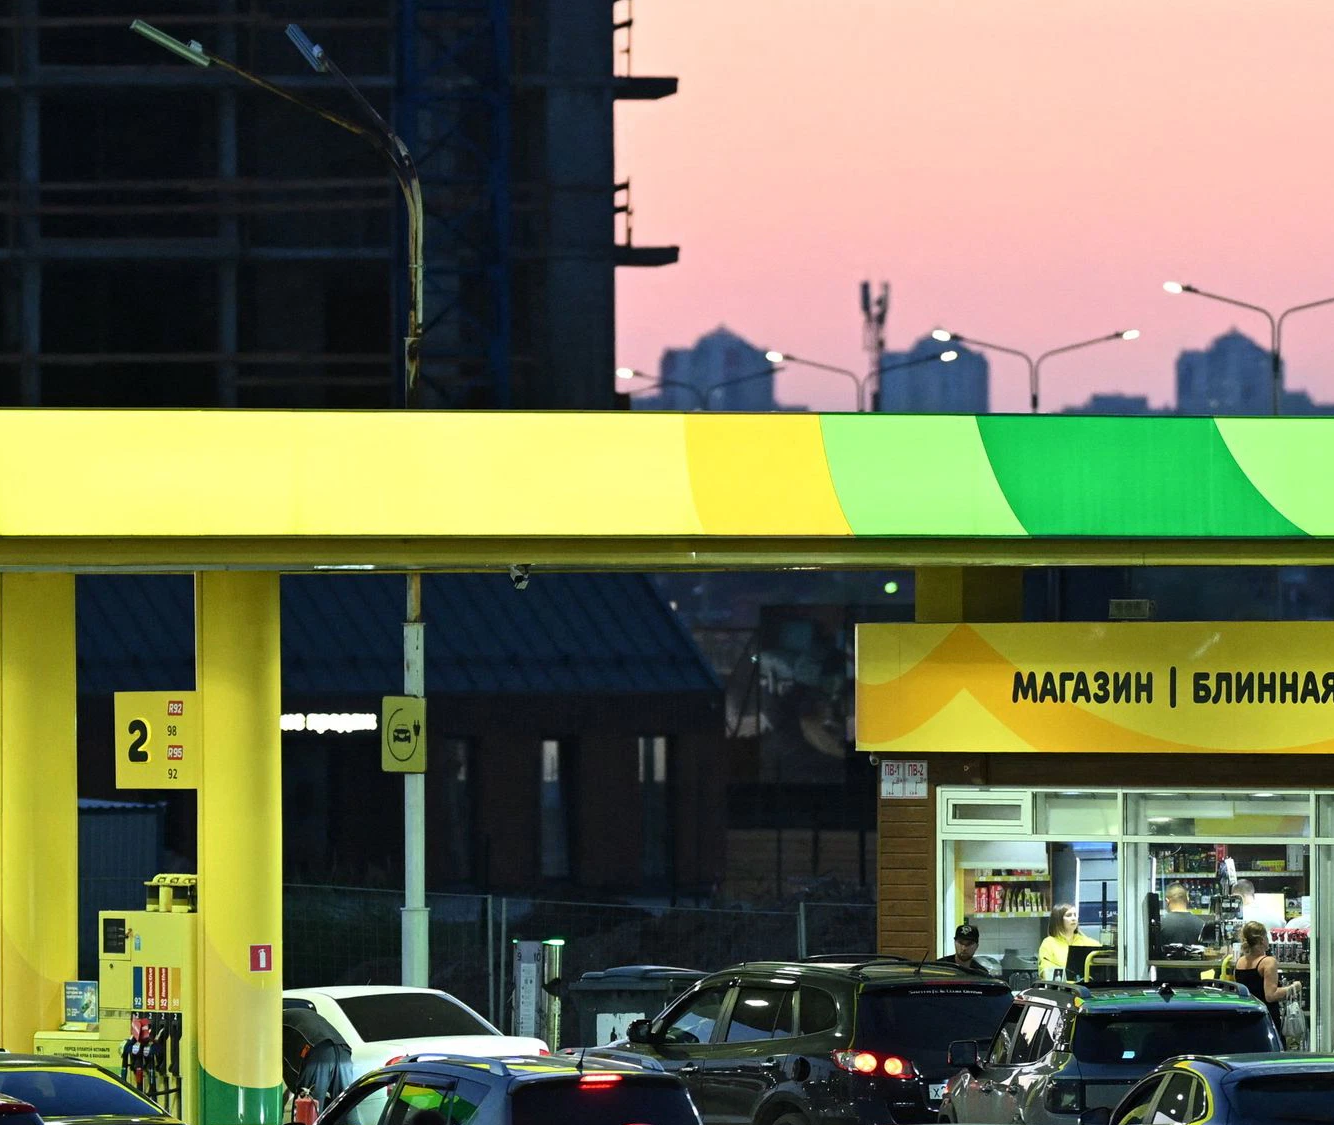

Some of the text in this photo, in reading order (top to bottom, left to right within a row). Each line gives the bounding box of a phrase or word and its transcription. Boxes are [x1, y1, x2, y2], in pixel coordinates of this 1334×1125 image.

[1012, 671, 1153, 704] МАГАЗИН
[168, 703, 182, 714] R92
[167, 725, 177, 736] 98
[128, 719, 149, 762] 2
[168, 747, 182, 758] R95
[168, 768, 178, 779] 92
[885, 764, 900, 776] ПВ-1
[908, 764, 923, 776] ПВ-2
[134, 997, 142, 1006] 92
